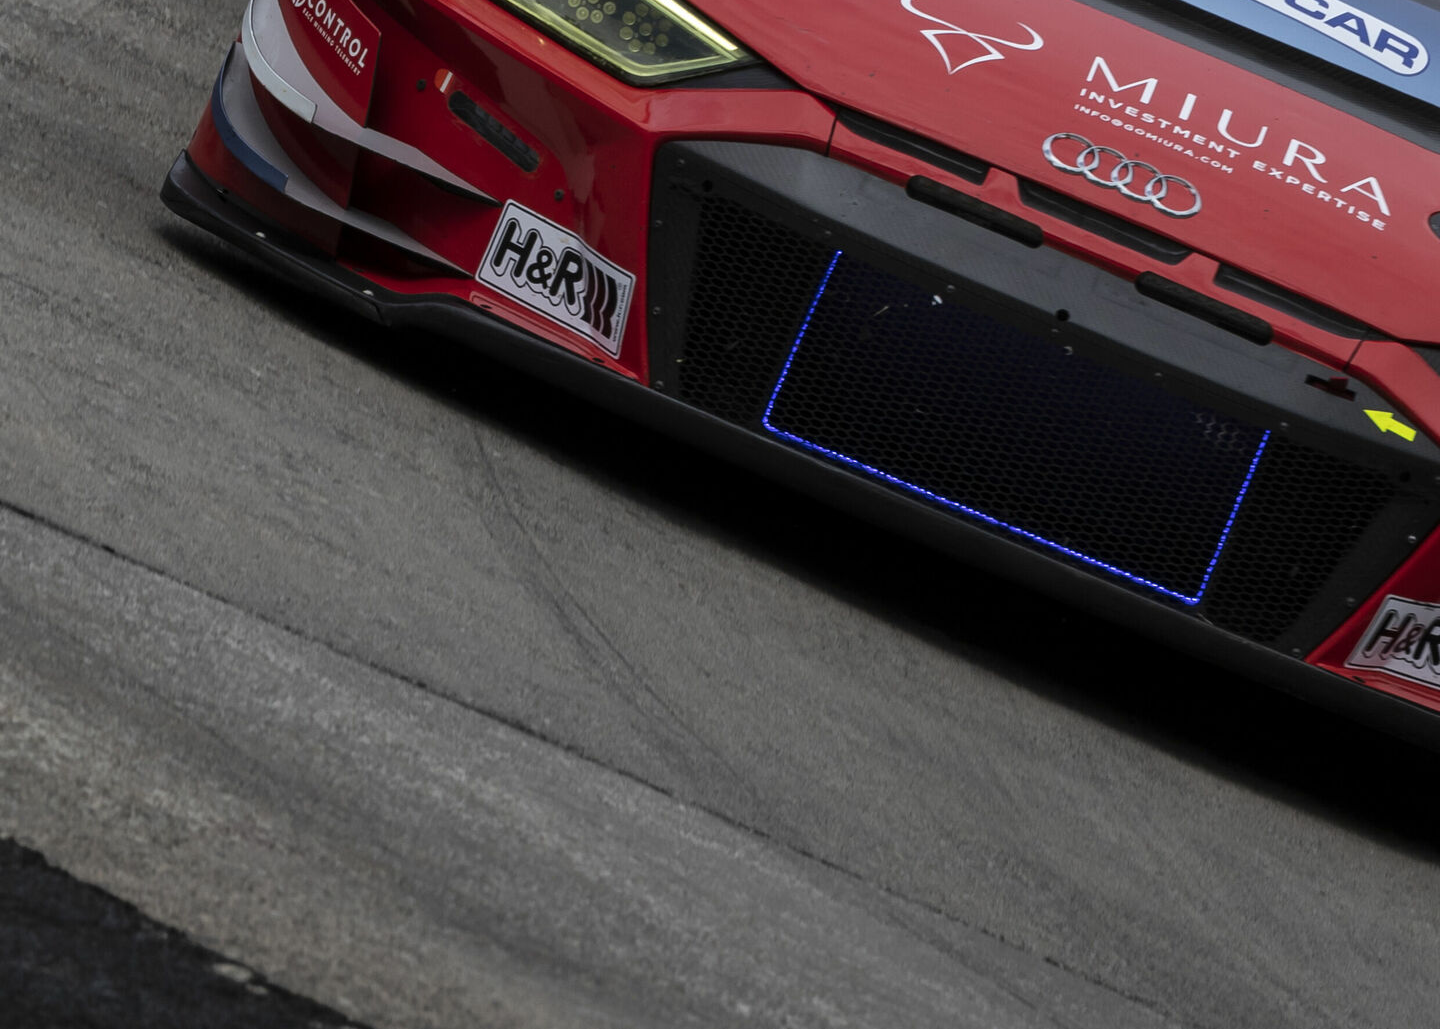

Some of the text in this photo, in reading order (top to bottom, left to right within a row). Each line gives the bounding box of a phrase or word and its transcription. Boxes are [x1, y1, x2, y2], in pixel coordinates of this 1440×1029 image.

[1074, 103, 1234, 174] INFO@GOMIURA.COM
[1079, 88, 1385, 232] INVESTMENT EXPERTISE
[1086, 56, 1392, 217] MIURA
[491, 218, 585, 313] H&R
